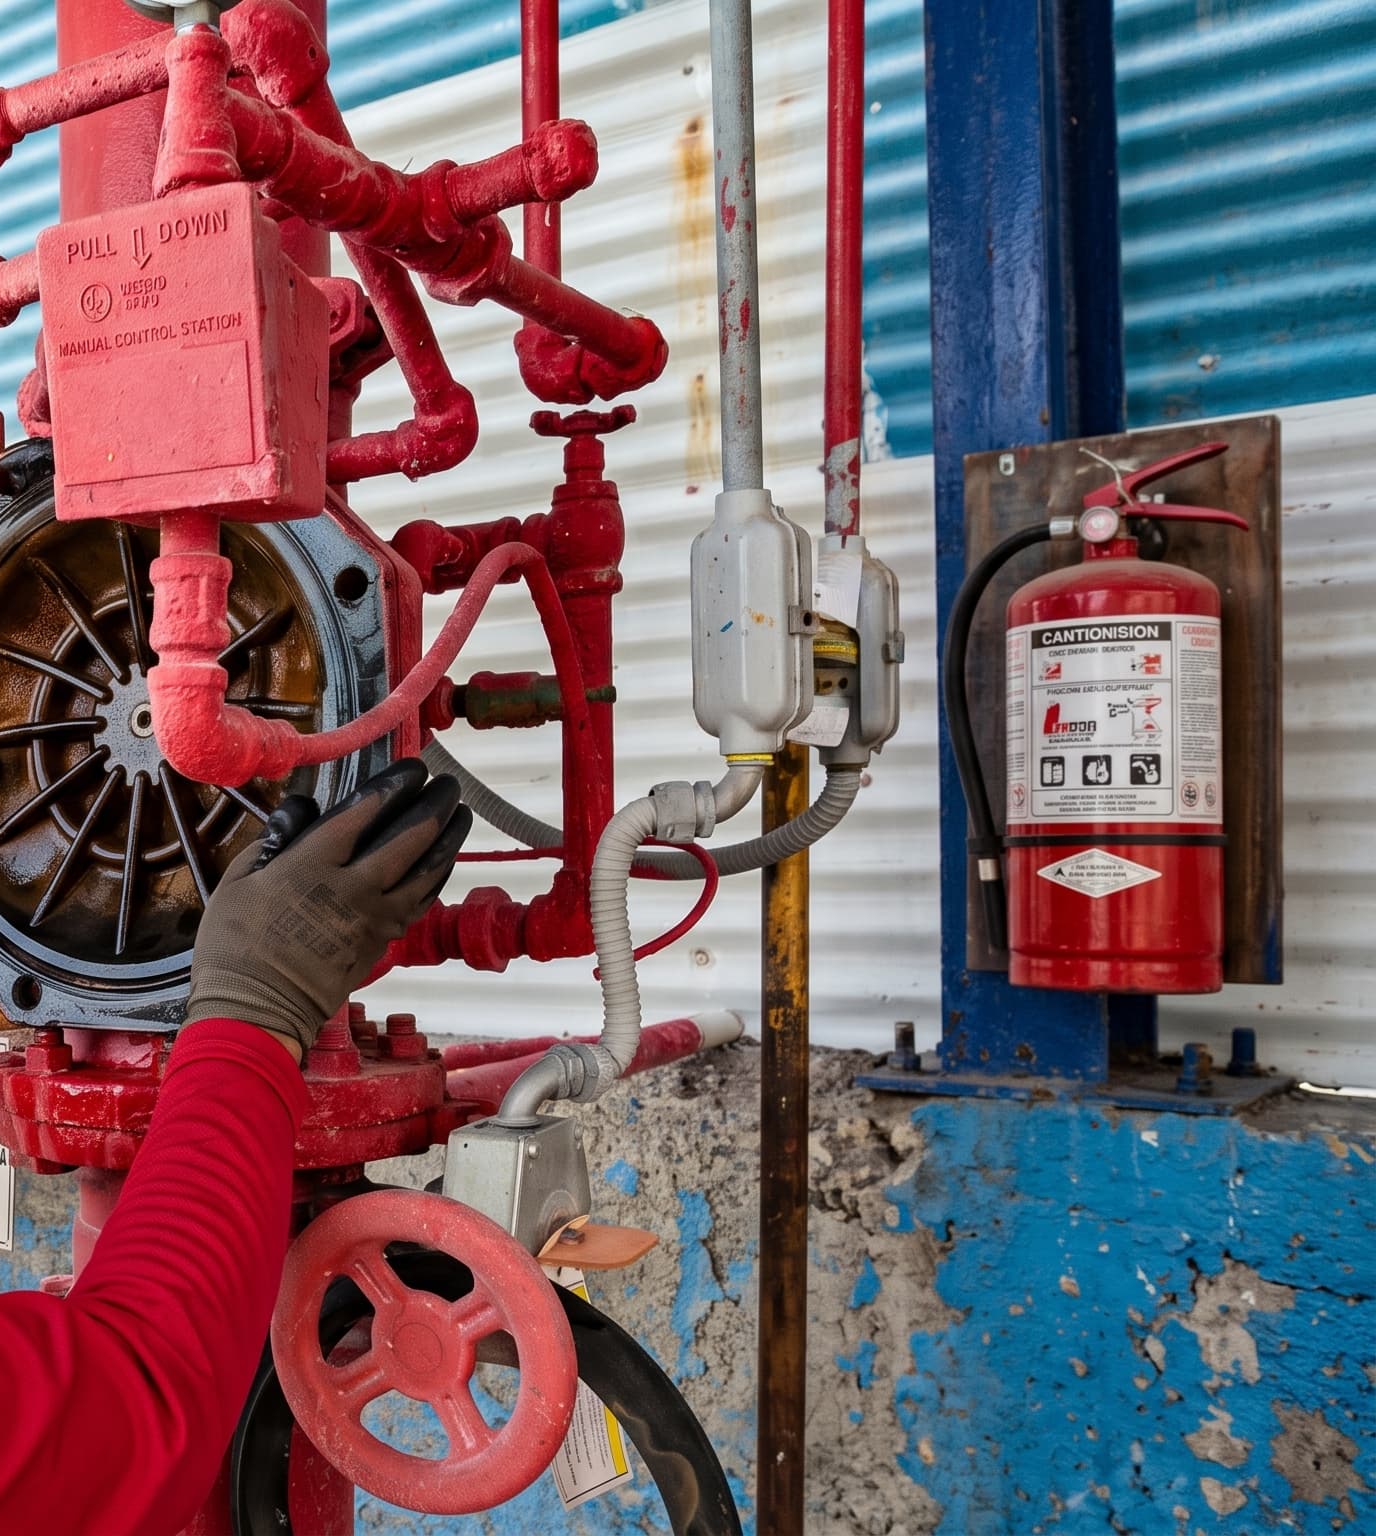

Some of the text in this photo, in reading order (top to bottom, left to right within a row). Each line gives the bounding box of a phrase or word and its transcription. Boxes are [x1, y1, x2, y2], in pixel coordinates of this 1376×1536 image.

[67, 209, 228, 264] PULL DOWN
[59, 312, 242, 358] MANUAL CONTROL STATION
[1042, 625, 1160, 646] CANTIONISION
